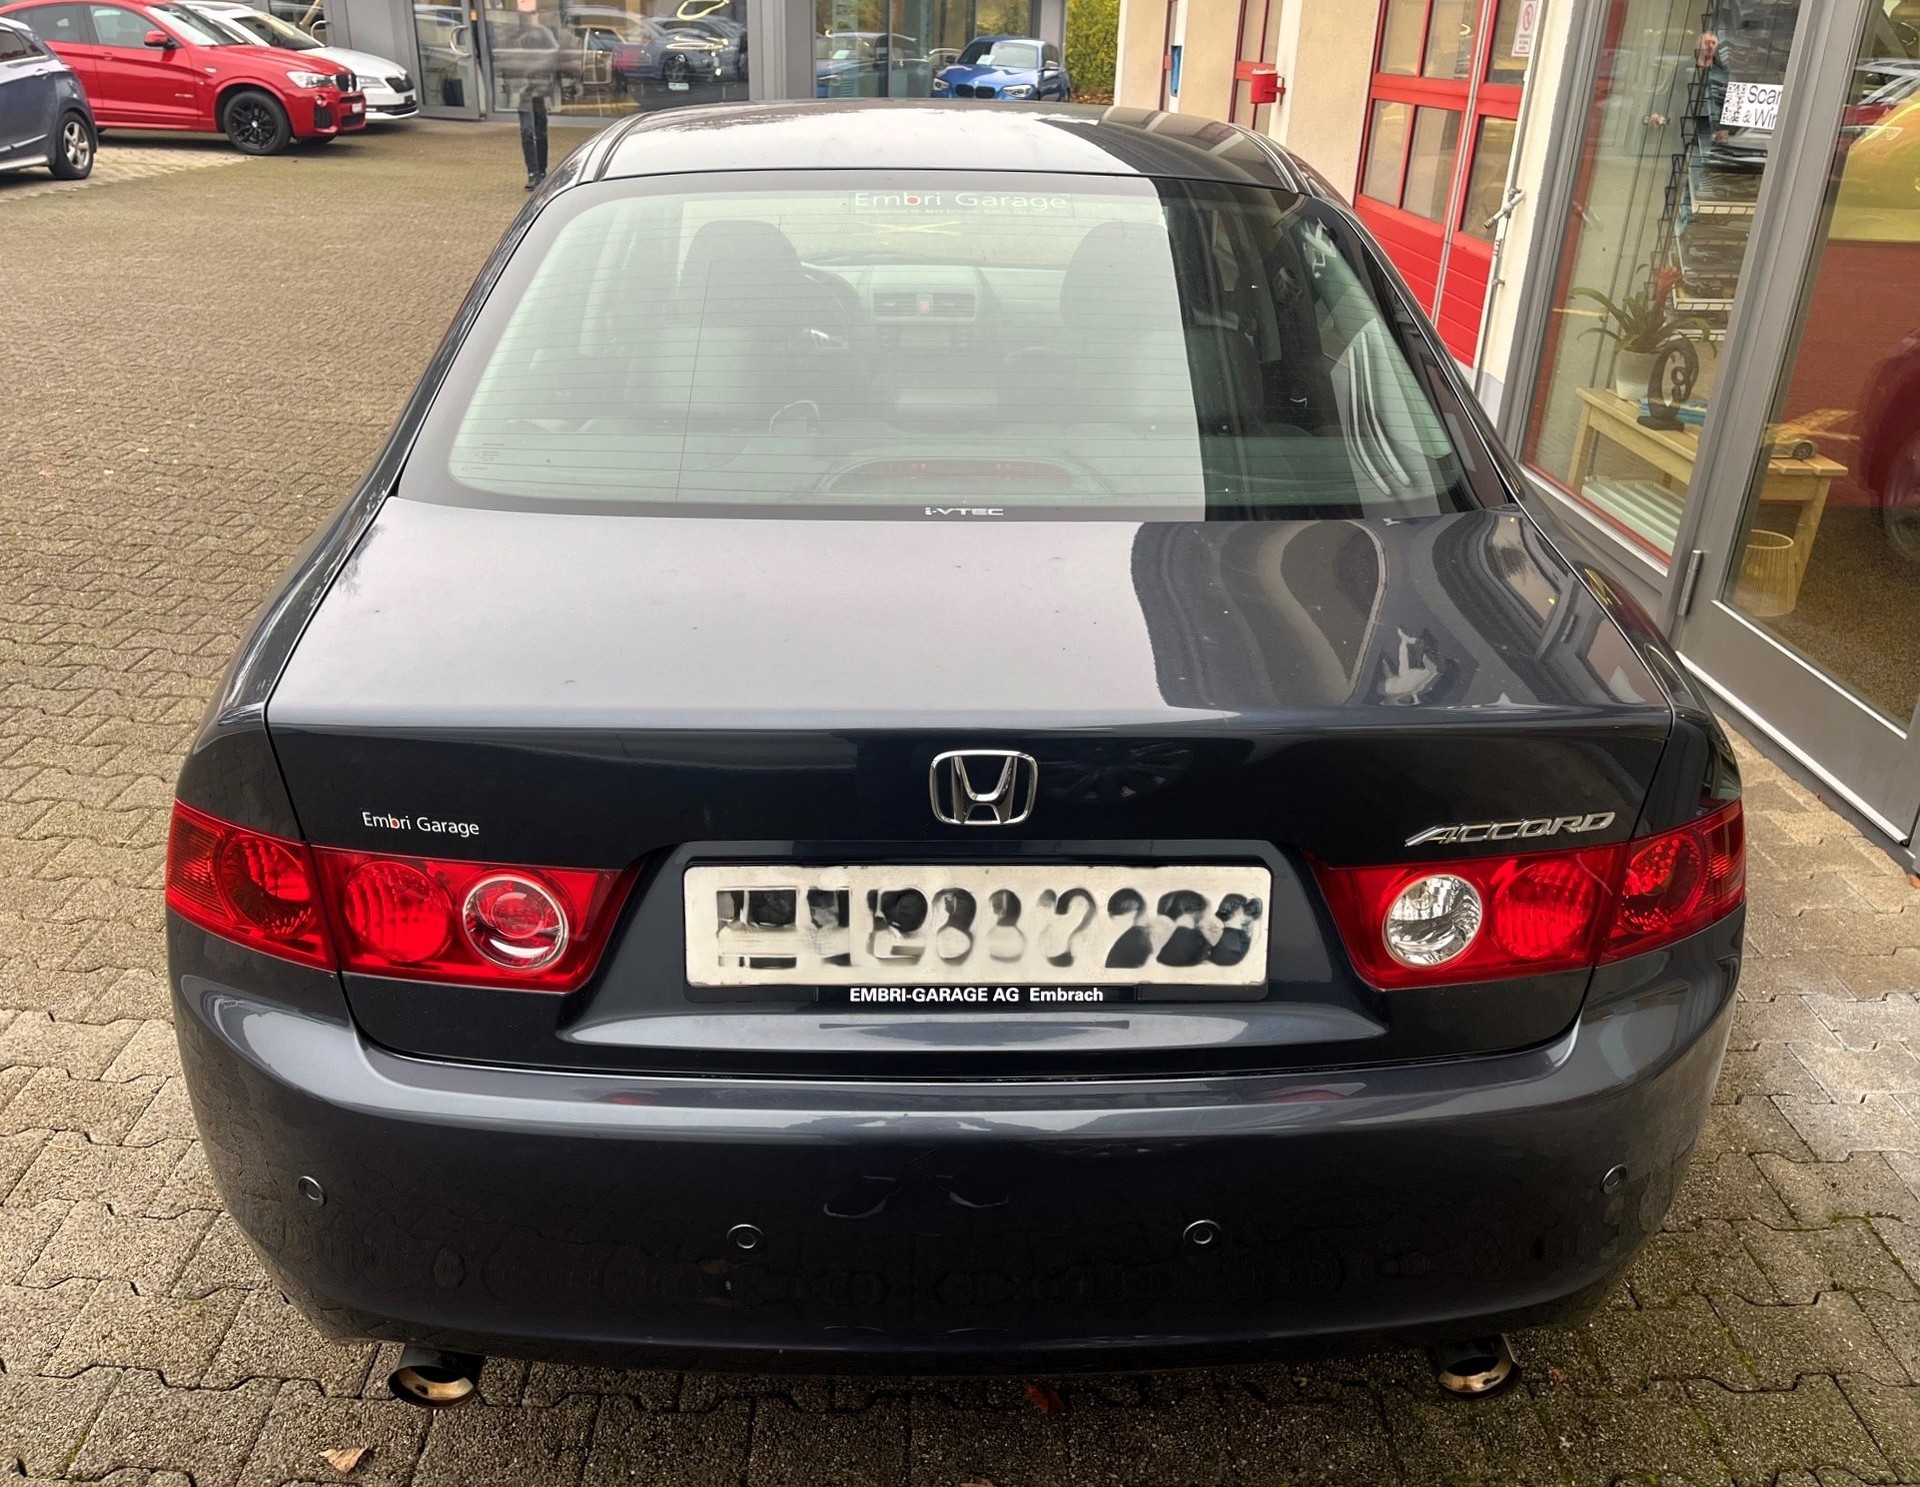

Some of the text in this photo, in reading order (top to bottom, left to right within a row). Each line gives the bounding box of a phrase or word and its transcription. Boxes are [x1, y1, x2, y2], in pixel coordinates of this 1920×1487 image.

[1743, 110, 1751, 123] &
[855, 192, 1068, 211] Embri Garage
[362, 811, 480, 838] Embri Garage
[1404, 811, 1616, 847] ACCORD
[850, 987, 1104, 1002] EMBRI-GARAGE AG Embrach
